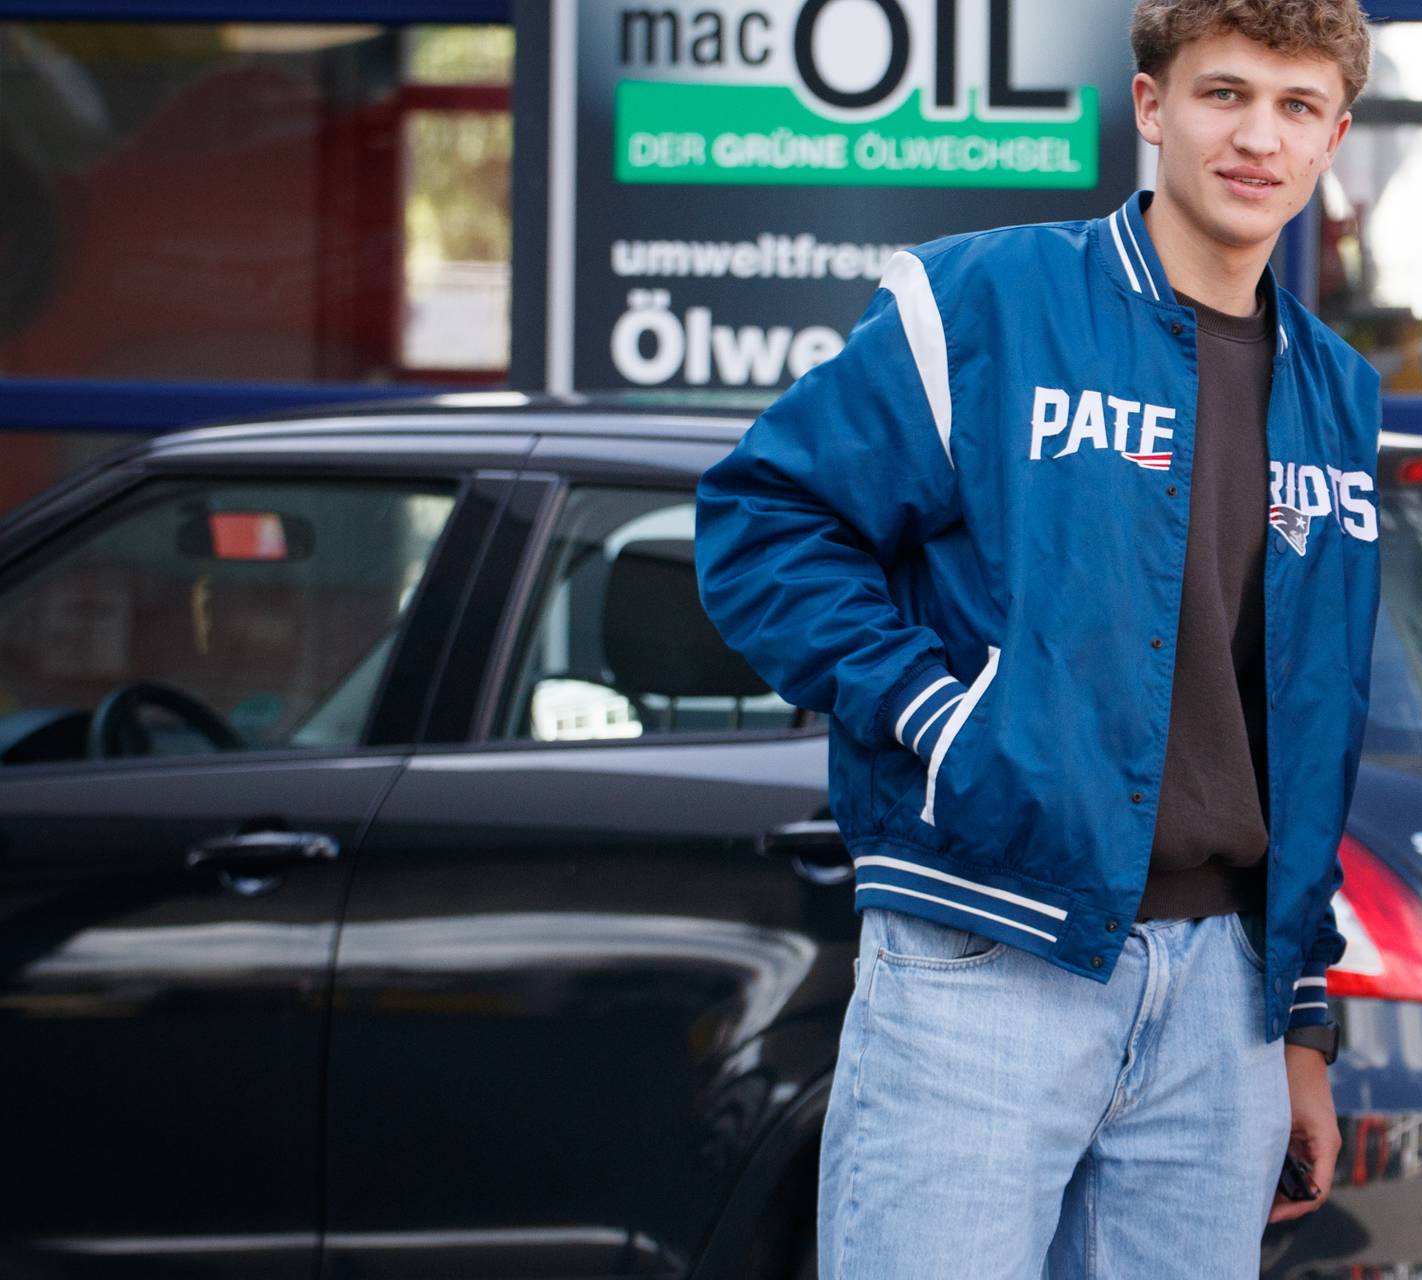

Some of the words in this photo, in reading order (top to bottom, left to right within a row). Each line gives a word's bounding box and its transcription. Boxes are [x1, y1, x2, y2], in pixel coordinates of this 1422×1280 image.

[619, 4, 772, 66] mac
[794, 0, 1070, 108] OIL
[628, 132, 702, 168] DER
[711, 127, 848, 169] GRÜNE
[854, 129, 1081, 173] ÖLWECHSEL
[610, 233, 905, 279] umweltfreu
